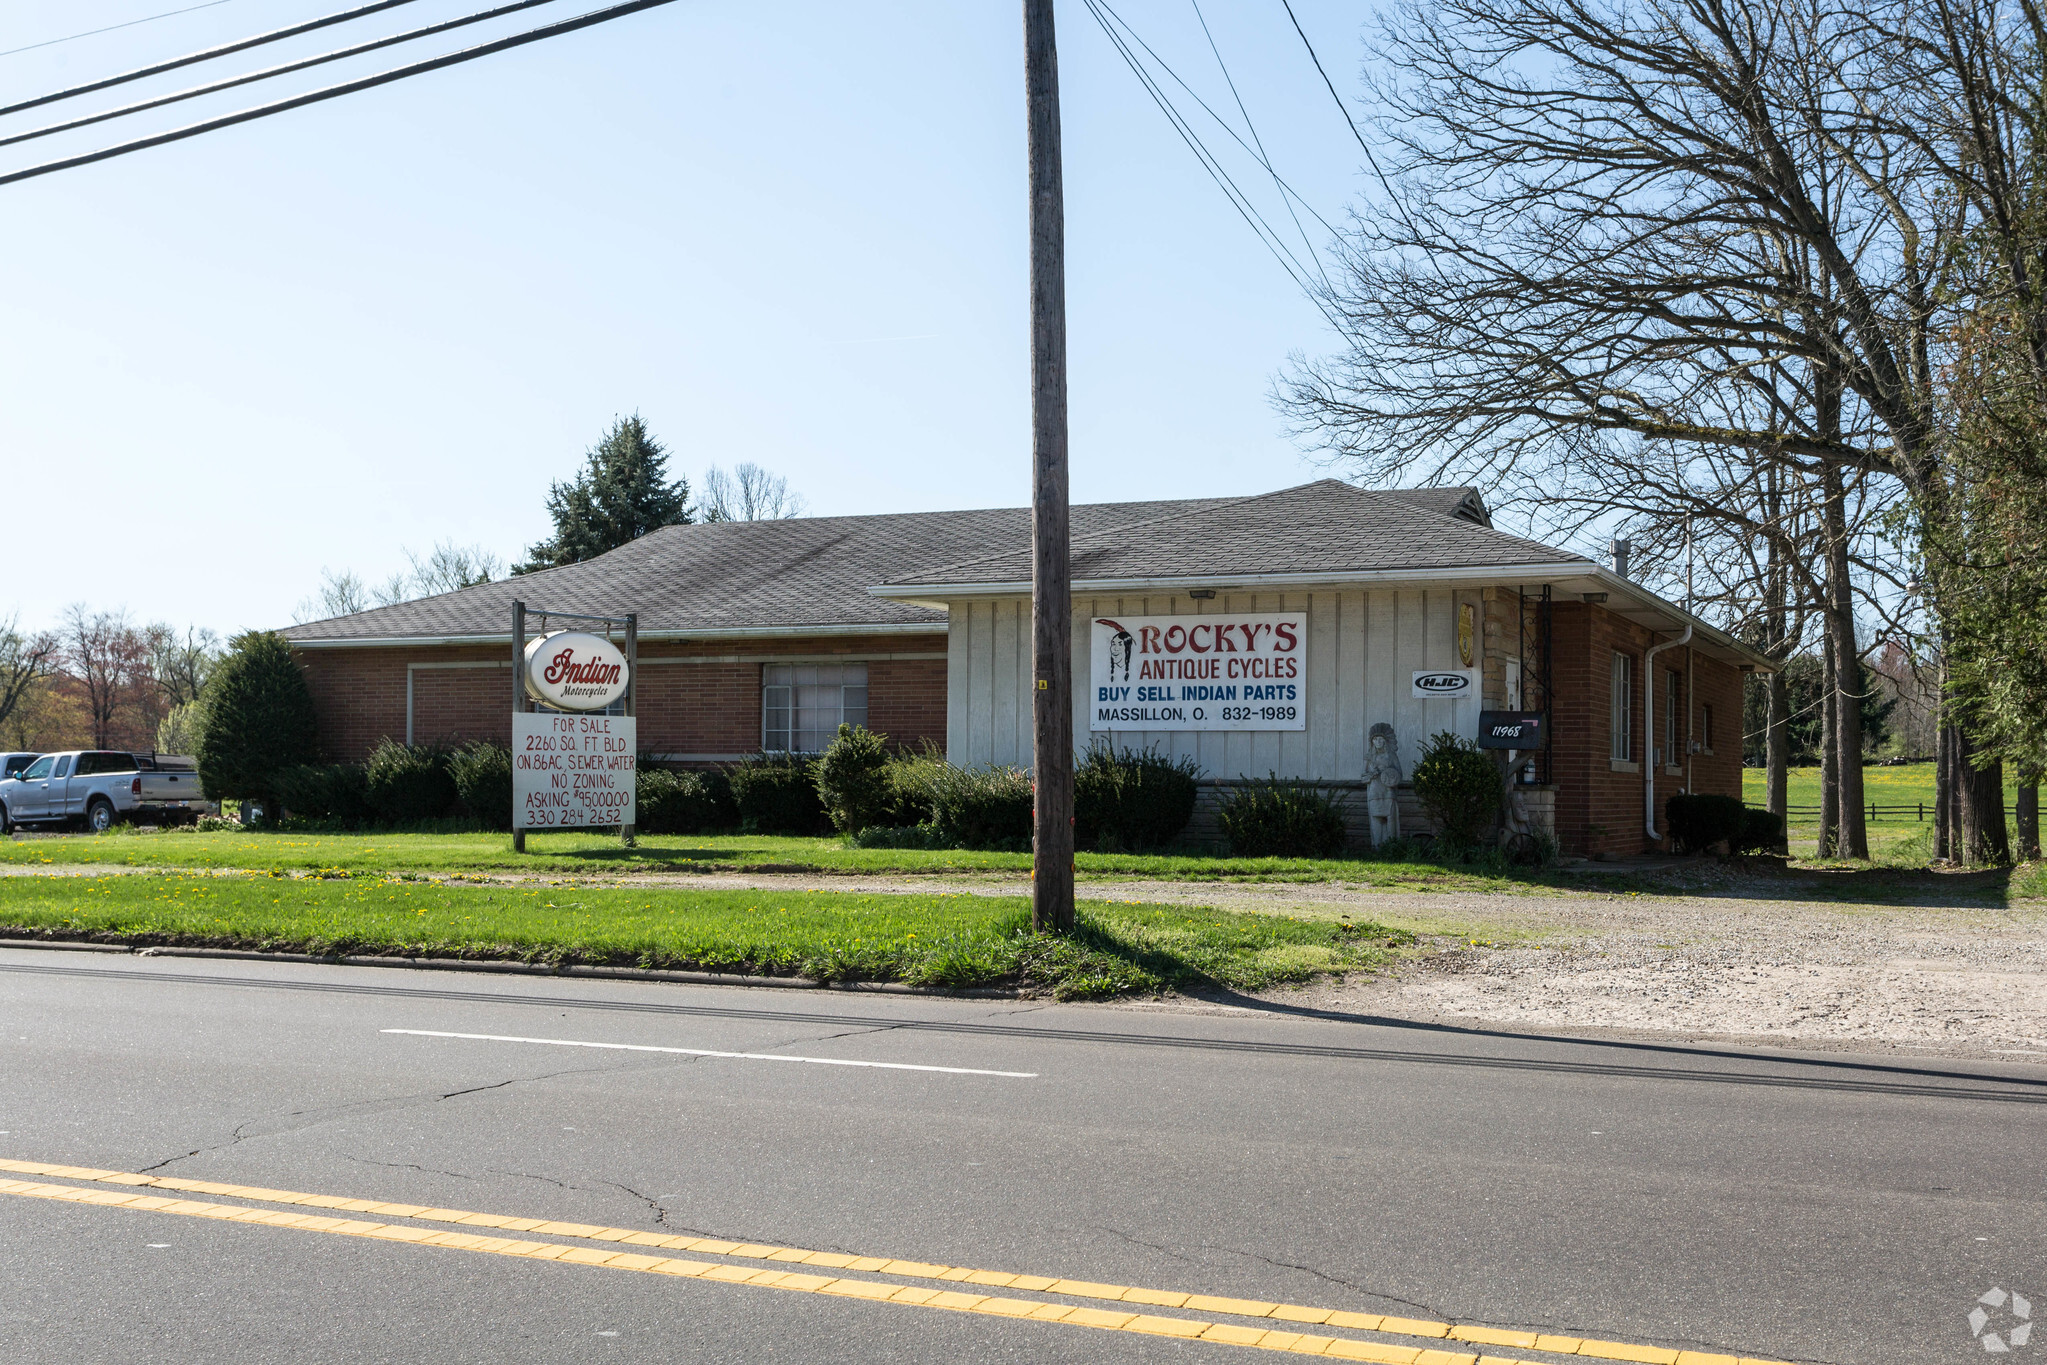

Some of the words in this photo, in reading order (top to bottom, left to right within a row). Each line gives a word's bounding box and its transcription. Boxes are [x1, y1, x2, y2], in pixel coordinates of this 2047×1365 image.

[1139, 622, 1298, 654] ROCKY'S
[544, 648, 621, 685] Indian
[1139, 658, 1220, 680] ANTIQUE
[1227, 657, 1298, 679] CYCLES
[1423, 677, 1460, 687] HJC
[560, 685, 608, 698] Motorcycles
[1098, 686, 1131, 702] BUY
[1137, 686, 1175, 701] SELL
[1182, 685, 1237, 701] INDIAN
[1243, 684, 1297, 701] PARTS
[1098, 707, 1187, 723] MASSILLON,
[1192, 707, 1208, 721] O.
[1222, 706, 1296, 721] 832-1989
[553, 717, 575, 733] FOR
[580, 717, 611, 734] SALE
[1492, 725, 1522, 737] 11968
[526, 735, 557, 751] 2260
[551, 773, 568, 789] NO
[573, 773, 615, 789] ZONING
[526, 791, 570, 808] ASKING
[526, 810, 555, 825] 330
[560, 809, 584, 825] 284
[589, 809, 622, 824] 2652
